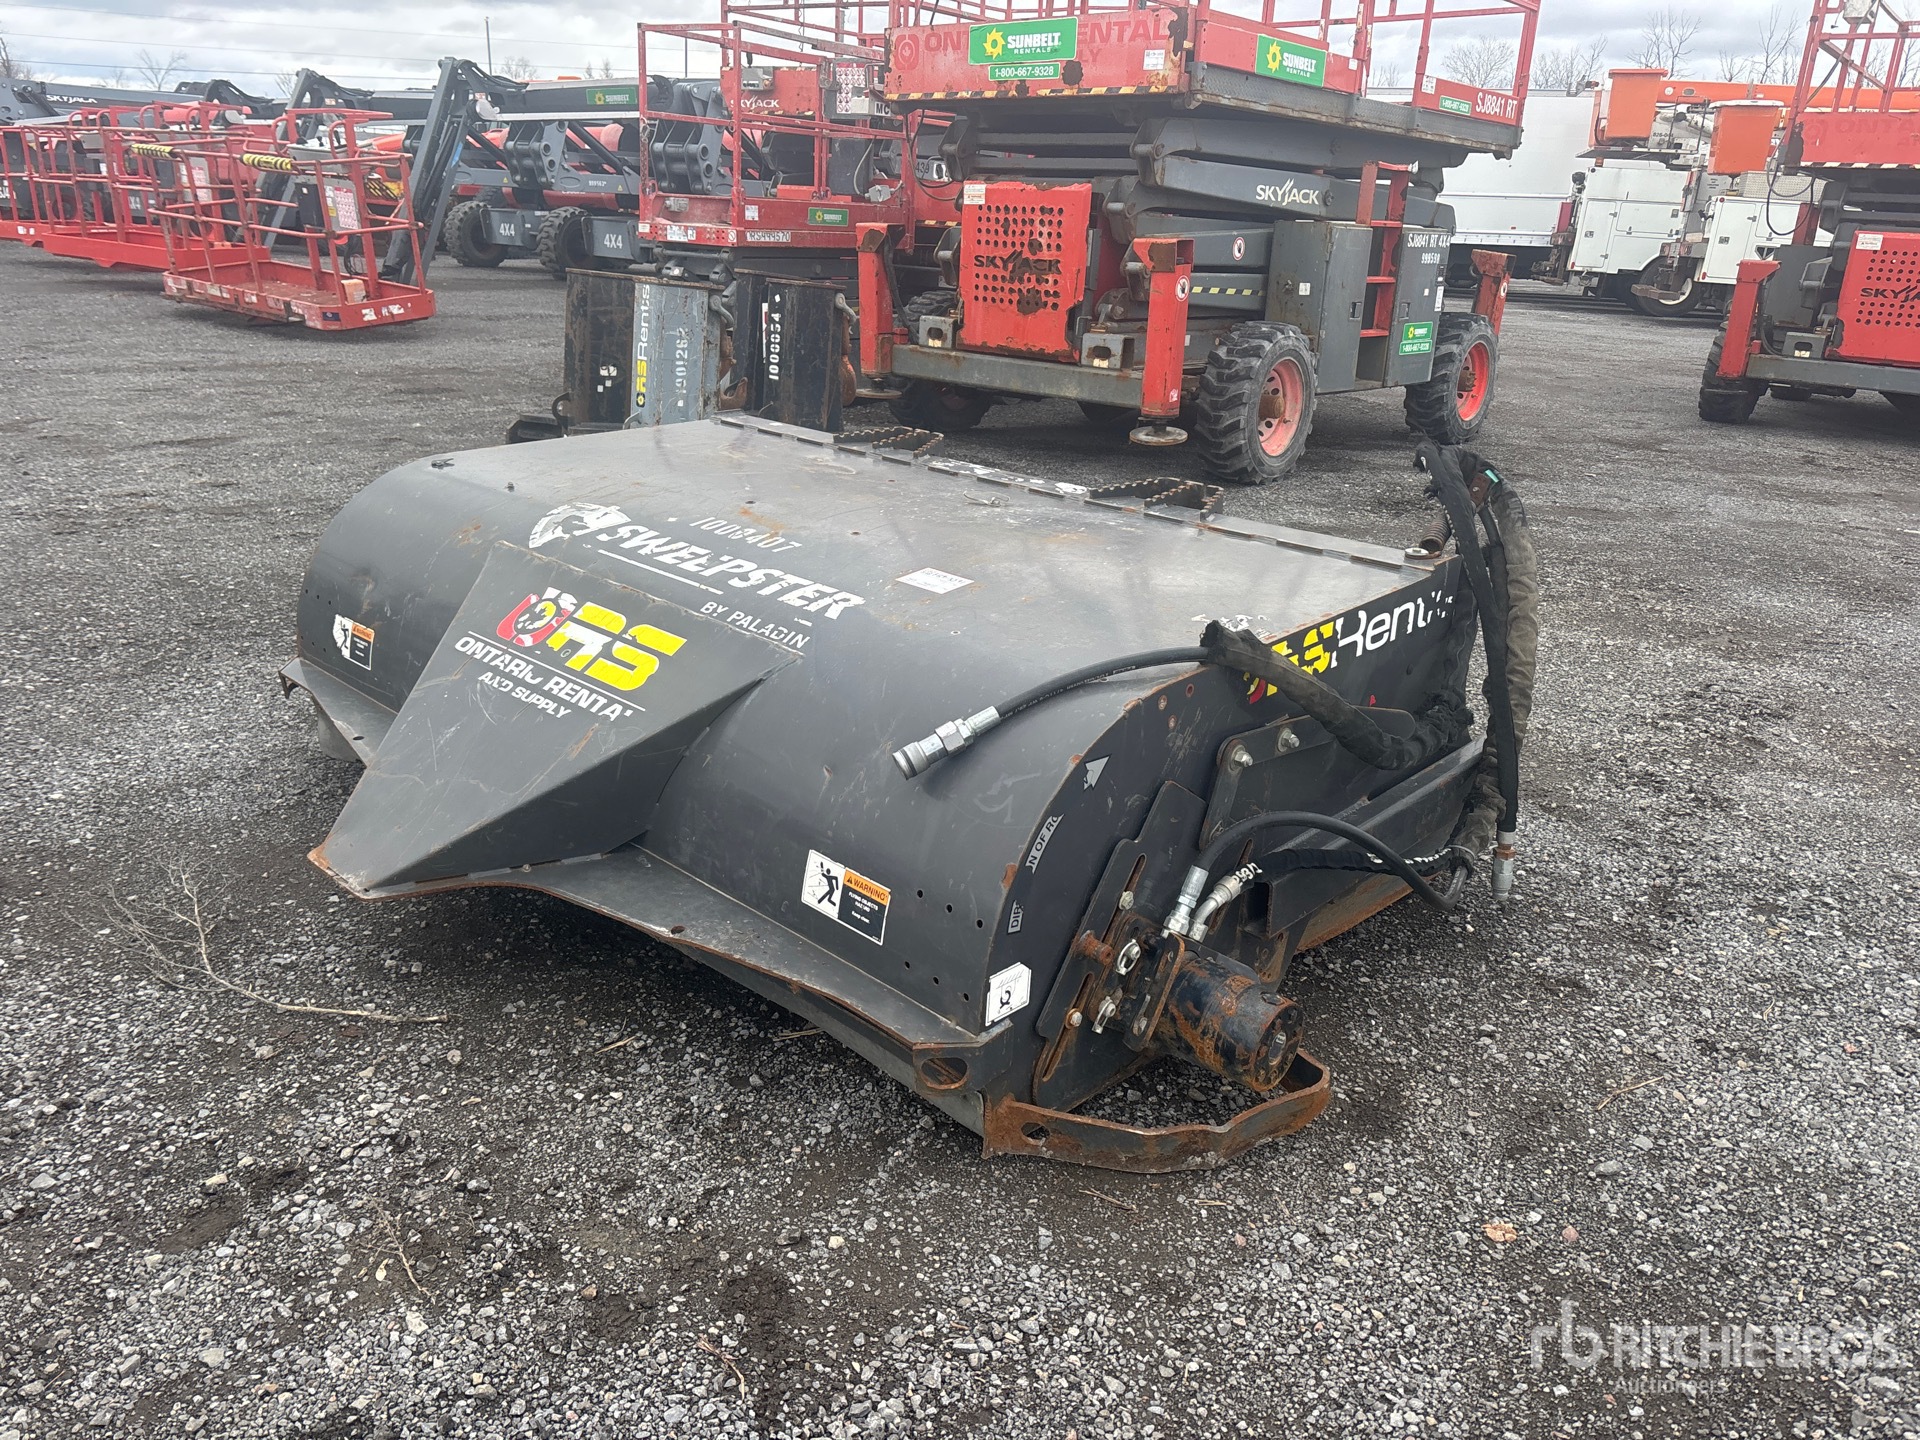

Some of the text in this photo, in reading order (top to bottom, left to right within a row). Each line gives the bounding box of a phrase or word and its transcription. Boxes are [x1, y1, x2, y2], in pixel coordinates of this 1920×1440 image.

[1007, 32, 1061, 49] SUNBELT
[994, 66, 1054, 78] 1-800-667-9328
[1282, 52, 1317, 73] SUNBELT
[730, 94, 779, 109] SKYJACK
[1475, 92, 1518, 119] SJ8841 RT
[1255, 177, 1320, 205] SKYJACK
[499, 223, 515, 236] 4X4
[1429, 234, 1438, 247] RT
[1438, 234, 1451, 247] 4X4
[603, 233, 623, 249] 4X4
[974, 249, 1062, 277] SKYJACK
[768, 313, 782, 380] 1000054
[595, 525, 866, 620] SWEEPSTER
[700, 601, 811, 649] BY PALADIN
[478, 671, 573, 718] AND SUPPLY
[1034, 834, 1047, 851] OF
[853, 878, 886, 901] WARNING
